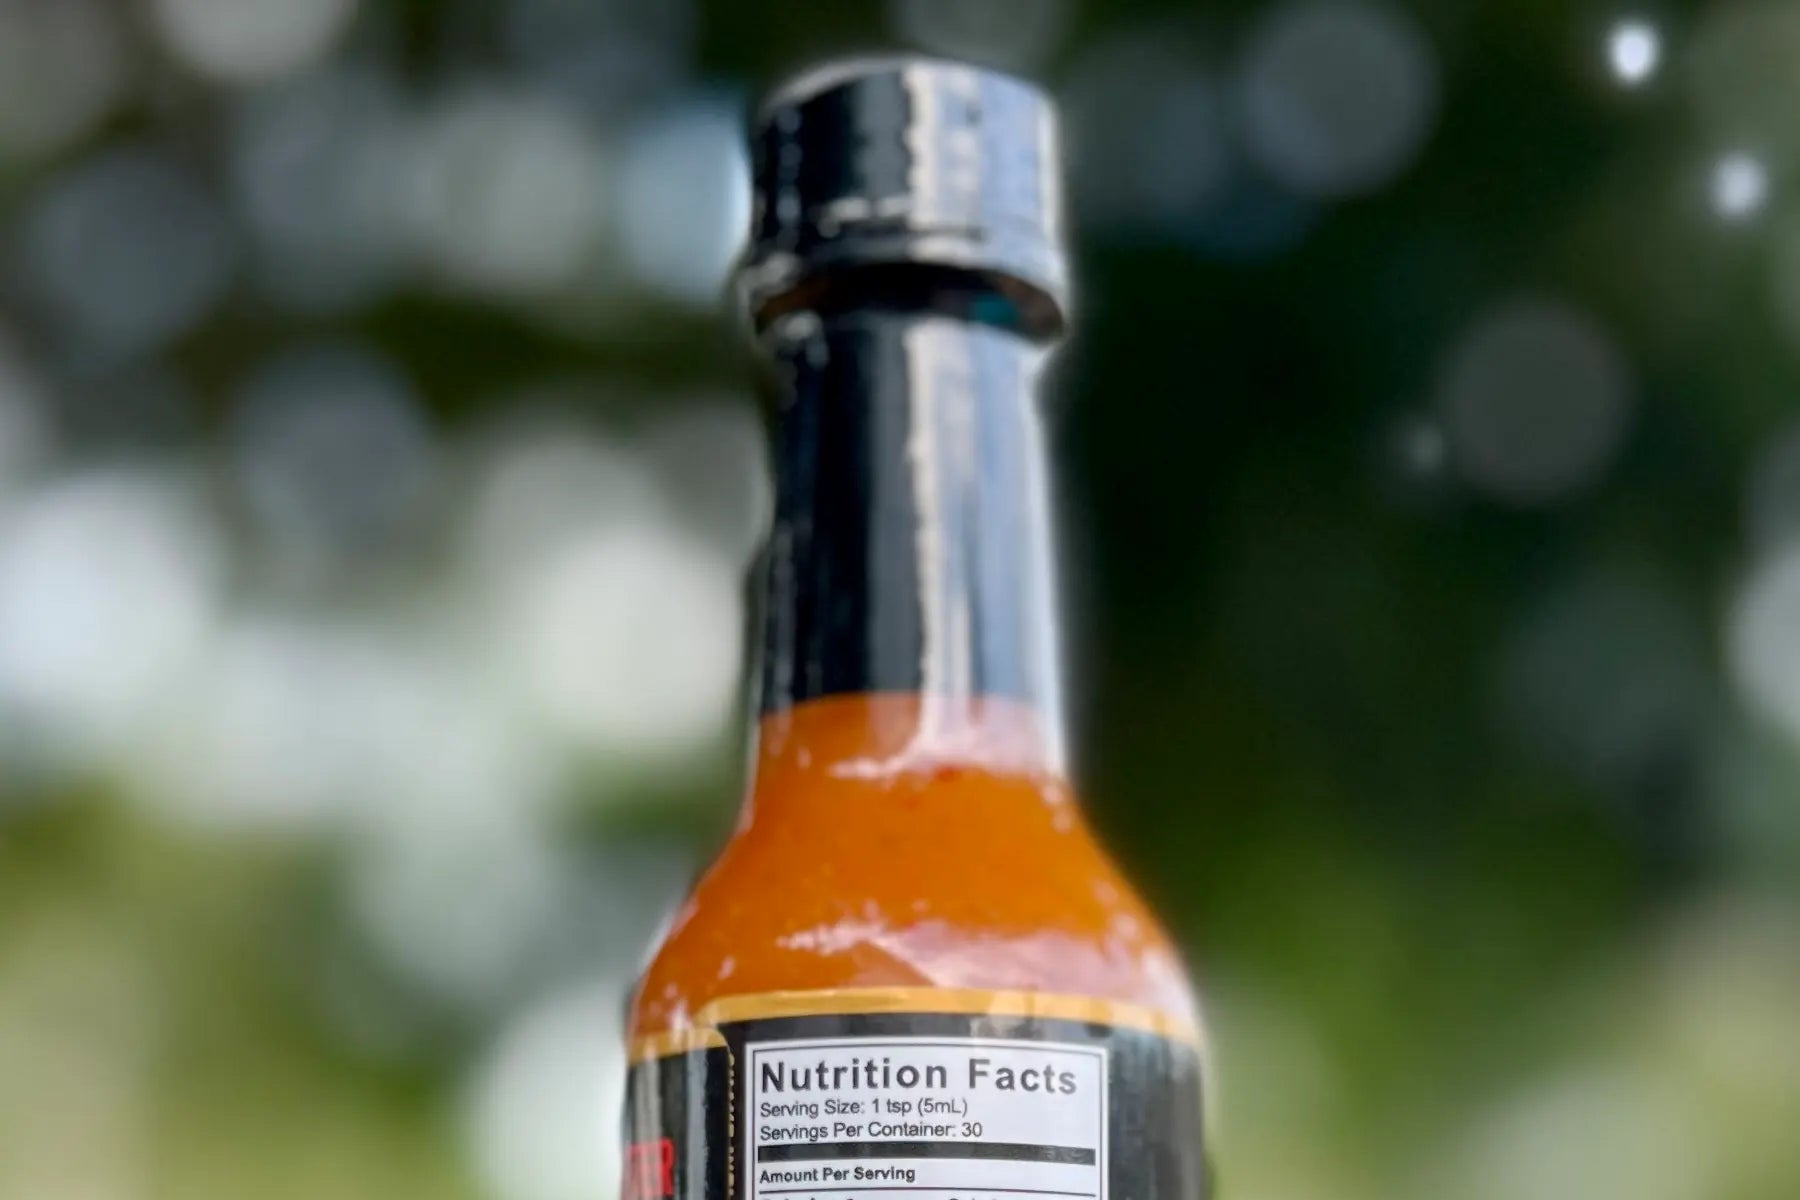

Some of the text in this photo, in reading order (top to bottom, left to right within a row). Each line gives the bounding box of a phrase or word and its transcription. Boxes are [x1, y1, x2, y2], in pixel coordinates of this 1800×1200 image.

[761, 1059, 1077, 1094] Nutrition Facts
[760, 1098, 967, 1119] Serving Size: 1 tsp (5mL)
[760, 1121, 983, 1141] Servings Per Container: 30
[759, 1167, 915, 1183] Amount Per Serving
